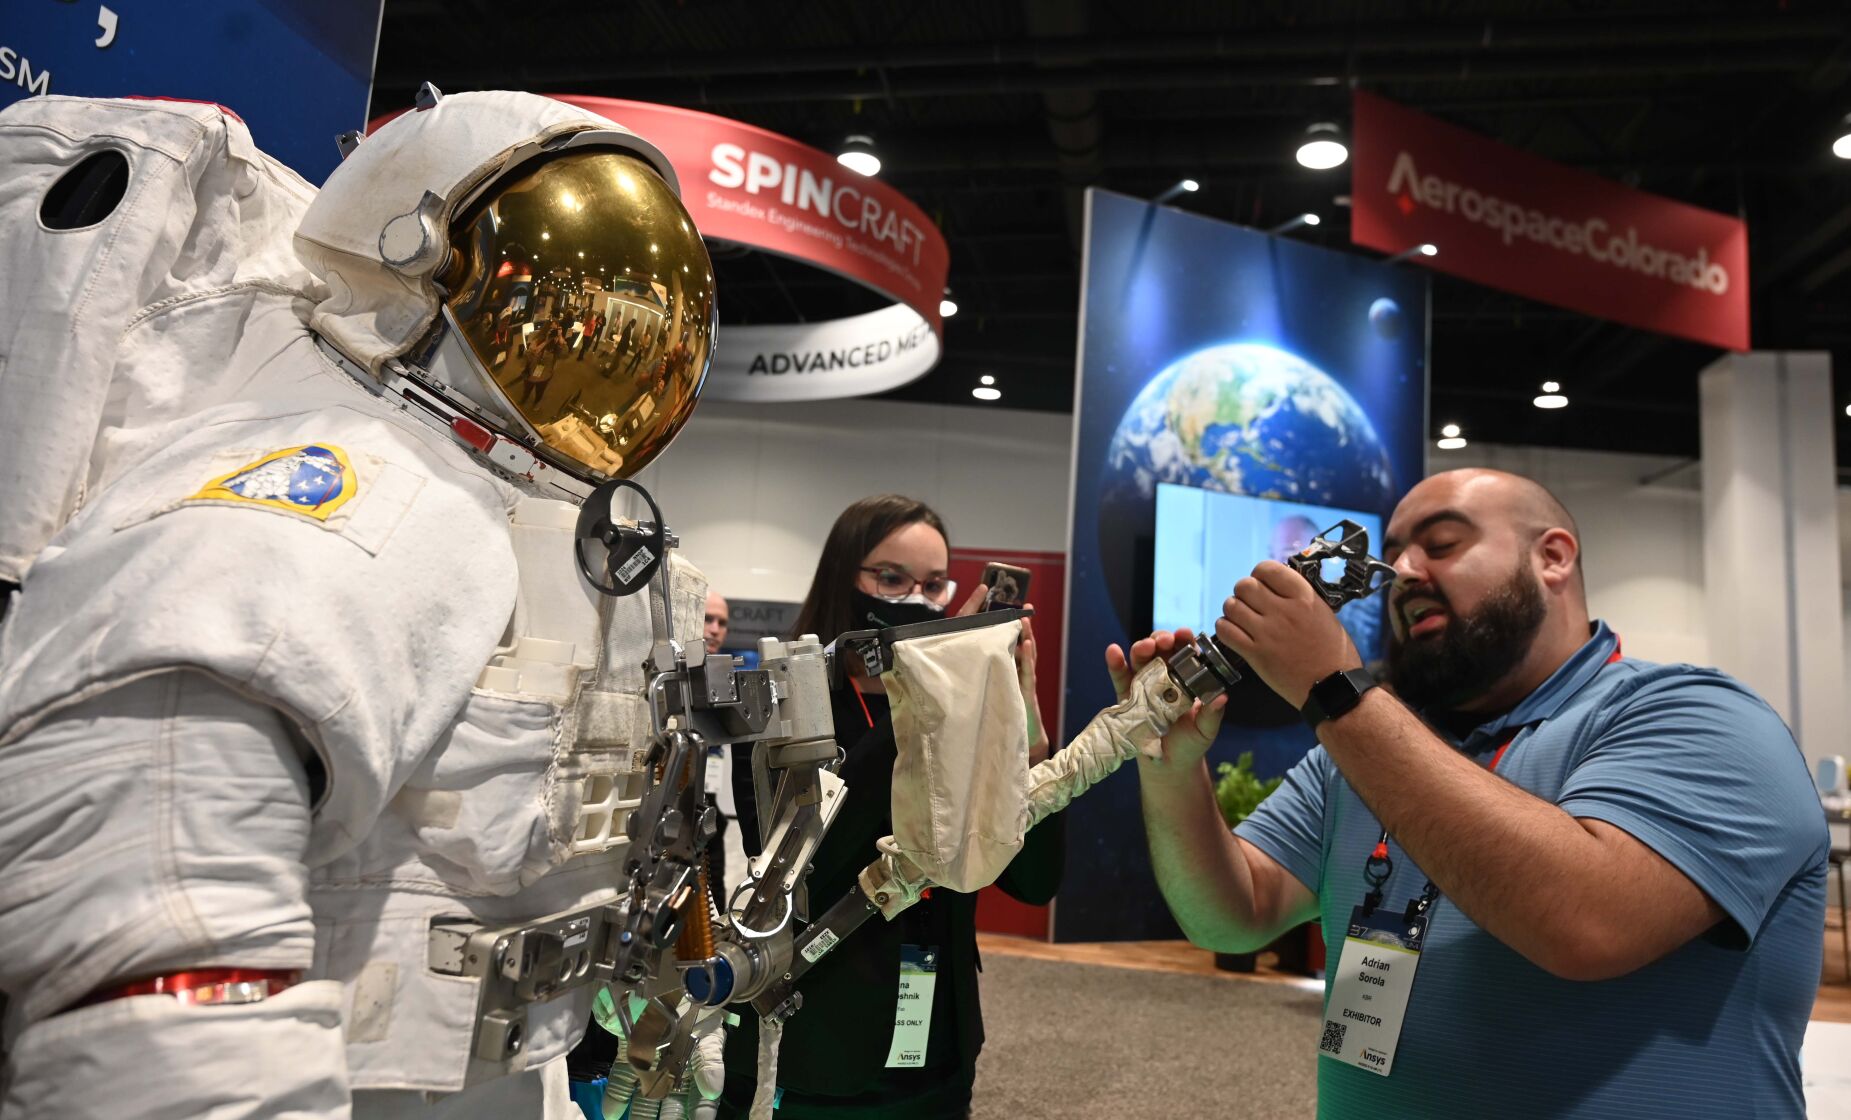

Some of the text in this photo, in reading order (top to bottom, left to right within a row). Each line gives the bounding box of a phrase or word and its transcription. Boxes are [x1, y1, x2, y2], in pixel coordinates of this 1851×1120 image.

[708, 143, 926, 266] SPINCRAFT
[706, 191, 764, 220] Standex
[767, 206, 845, 250] Engineering
[1387, 151, 1729, 296] AerospaceColorado
[748, 340, 891, 376] ADVANCED
[1361, 956, 1390, 972] Adrian
[1358, 971, 1385, 987] Sorola
[1342, 1008, 1382, 1027] EXHIBITOR
[897, 1053, 921, 1062] Ansys
[1359, 1048, 1386, 1066] Ansys
